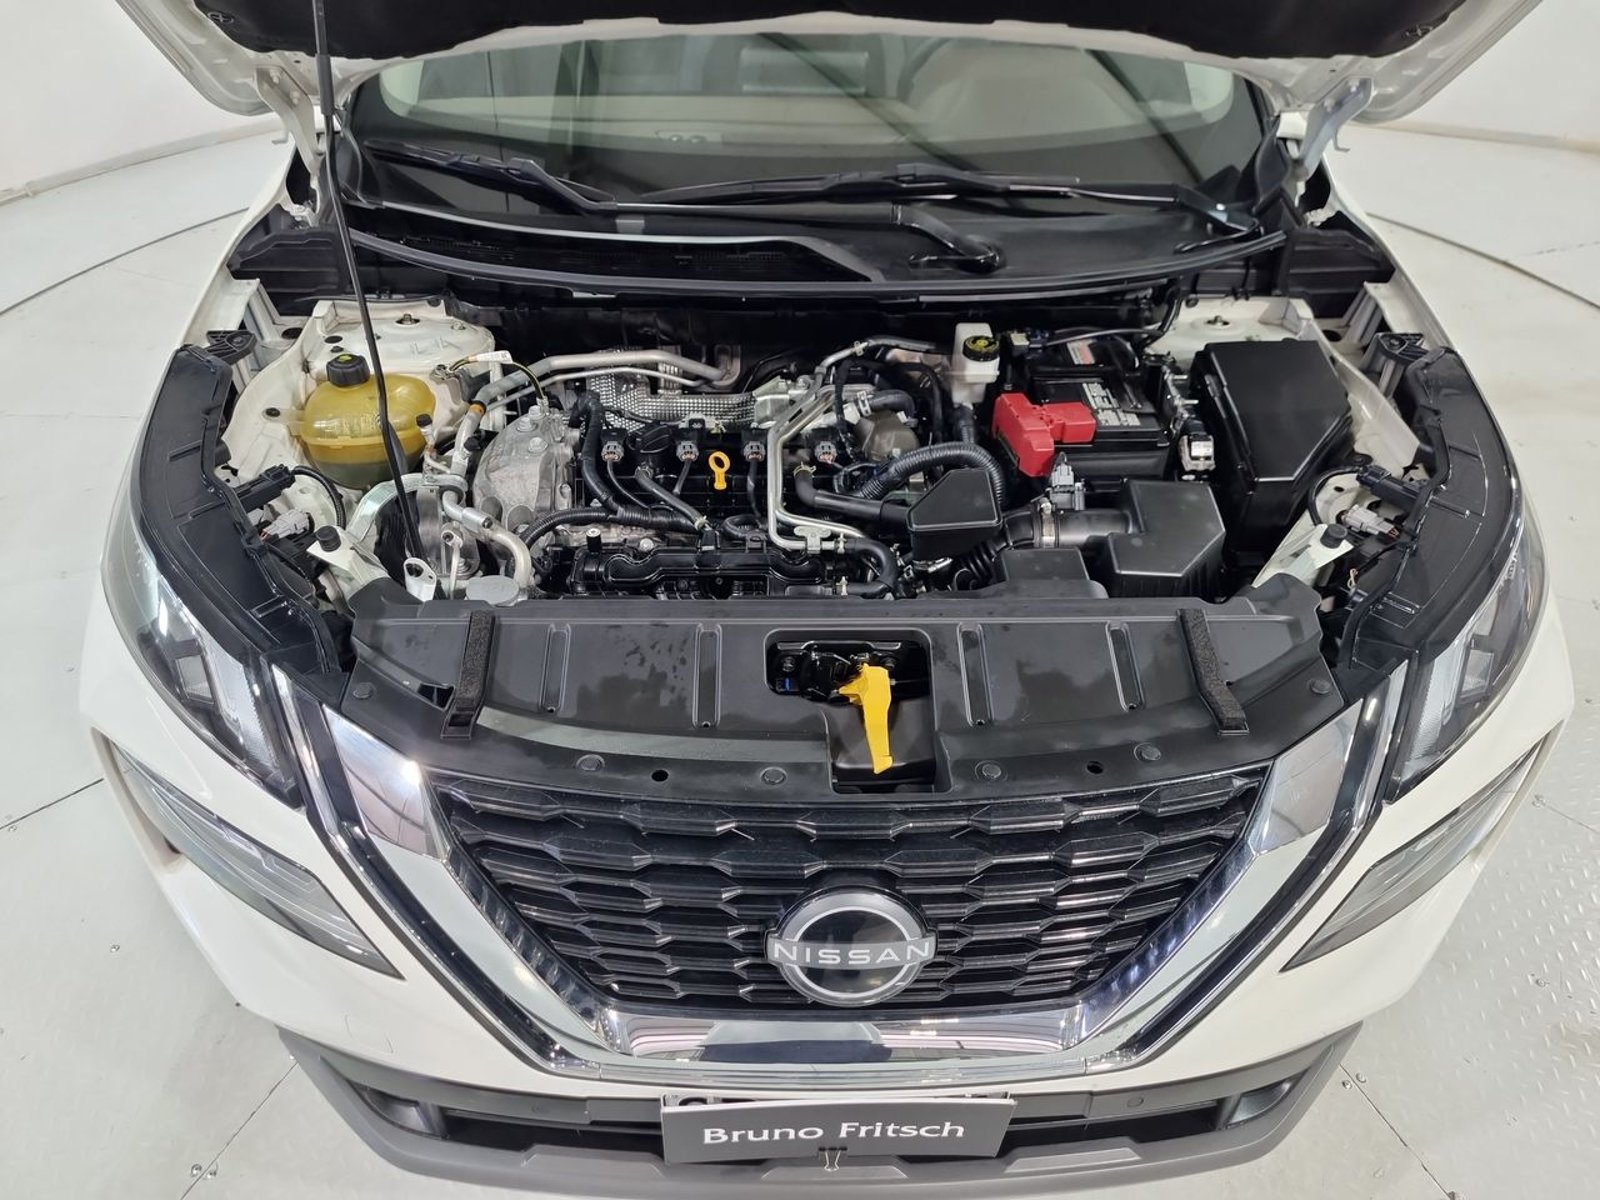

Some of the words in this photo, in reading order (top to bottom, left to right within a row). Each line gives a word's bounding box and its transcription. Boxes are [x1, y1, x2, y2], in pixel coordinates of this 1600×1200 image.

[773, 942, 930, 965] NISSAN
[703, 1127, 824, 1144] Bruno
[839, 1121, 965, 1138] Fritsch
